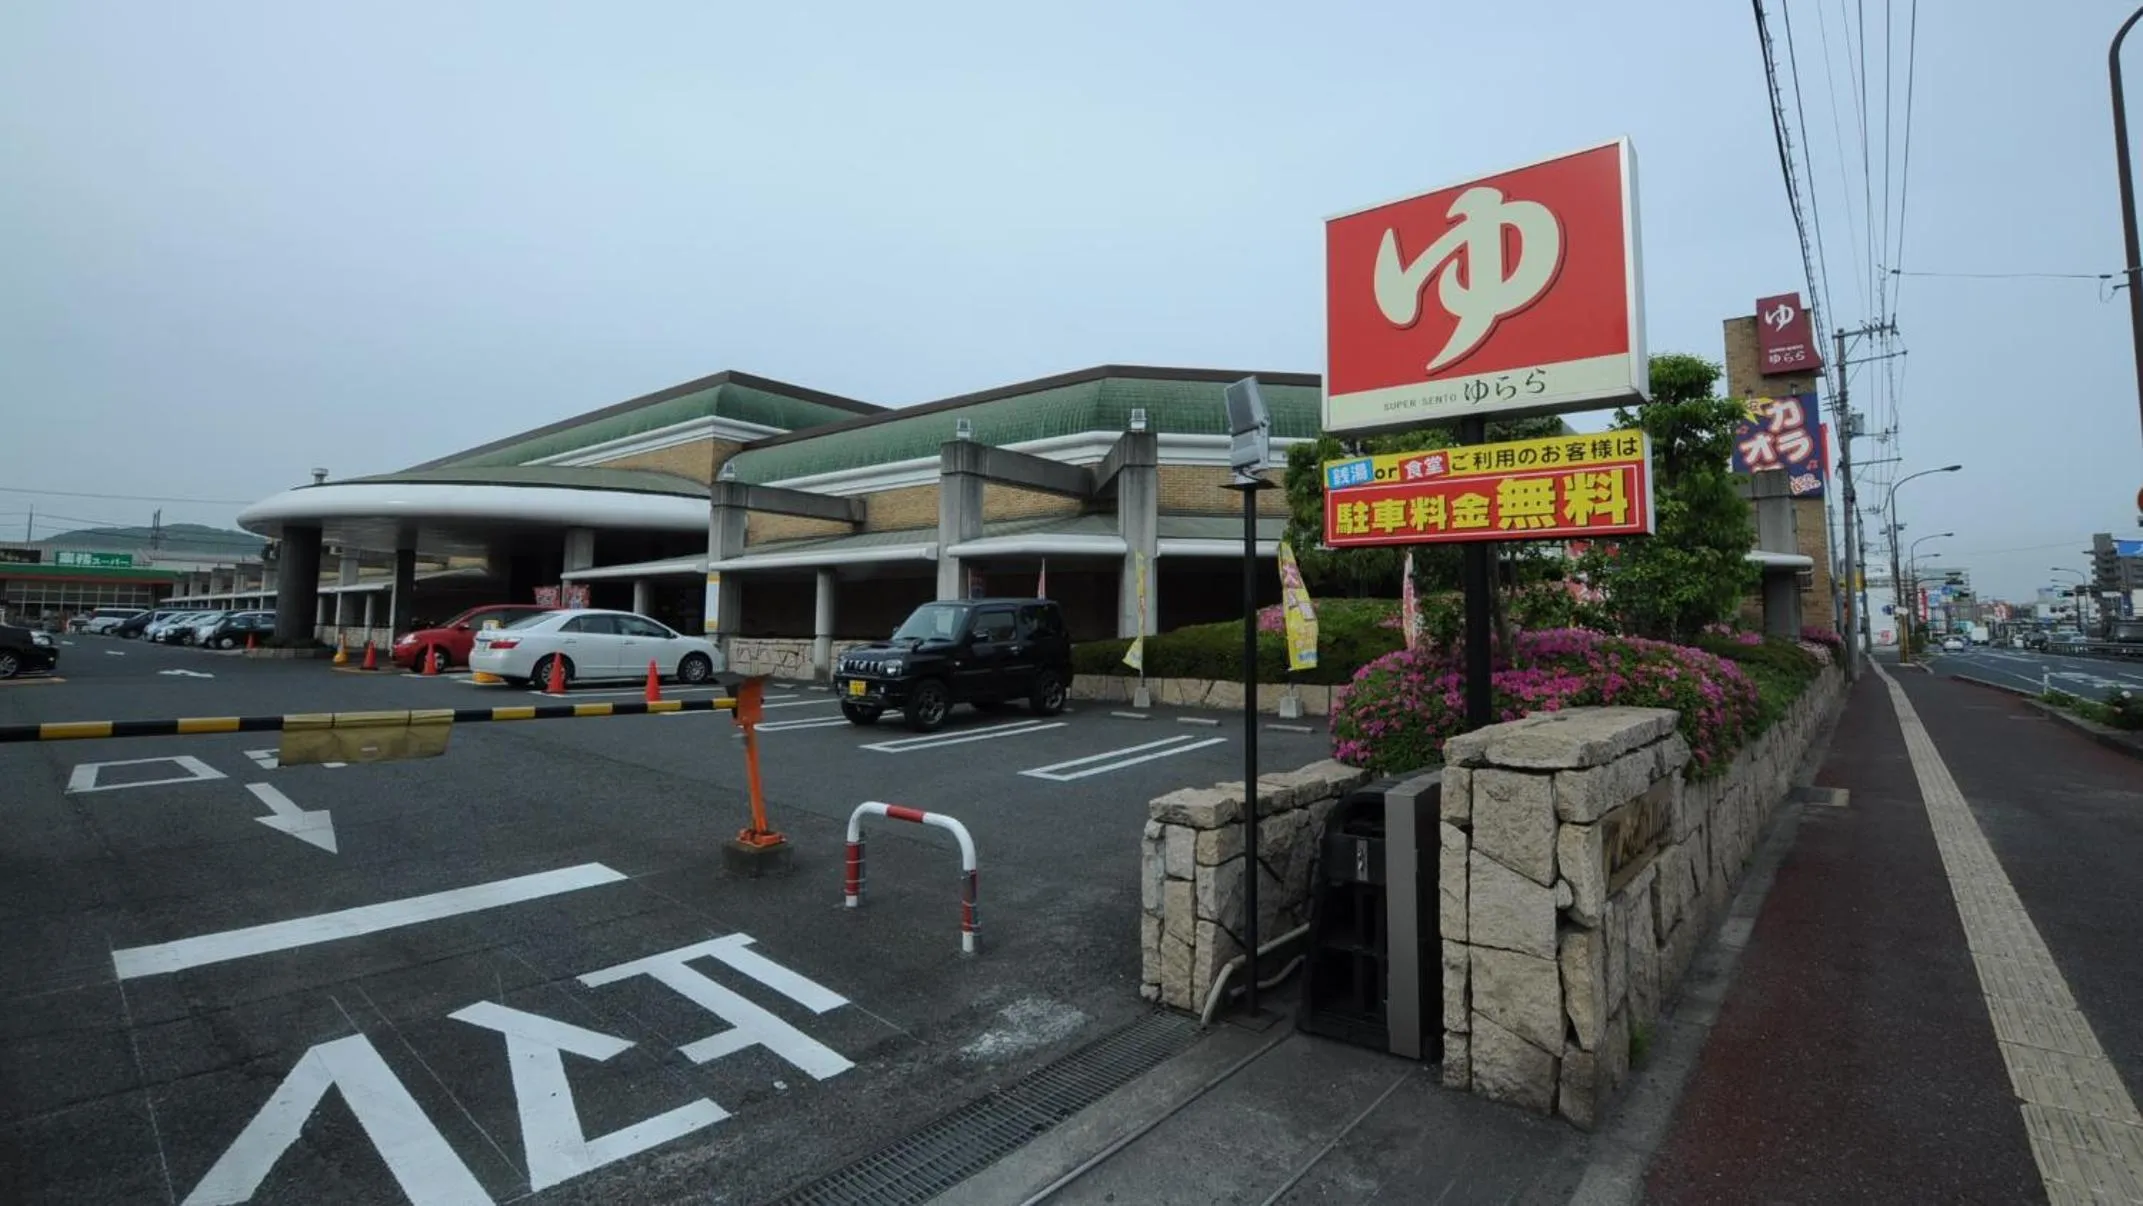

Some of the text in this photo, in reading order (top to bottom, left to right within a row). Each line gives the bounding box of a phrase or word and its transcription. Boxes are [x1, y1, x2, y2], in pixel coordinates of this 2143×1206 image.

[1374, 186, 1565, 373] ゆ
[1765, 304, 1795, 332] ゆ
[1769, 350, 1805, 364] ゆらら
[1384, 368, 1547, 411] SUPER SENTO ゆらら
[1331, 436, 1639, 485] 銭湯 or 食堂 ご利用のお客様は
[1336, 469, 1629, 535] 駐車料金無料
